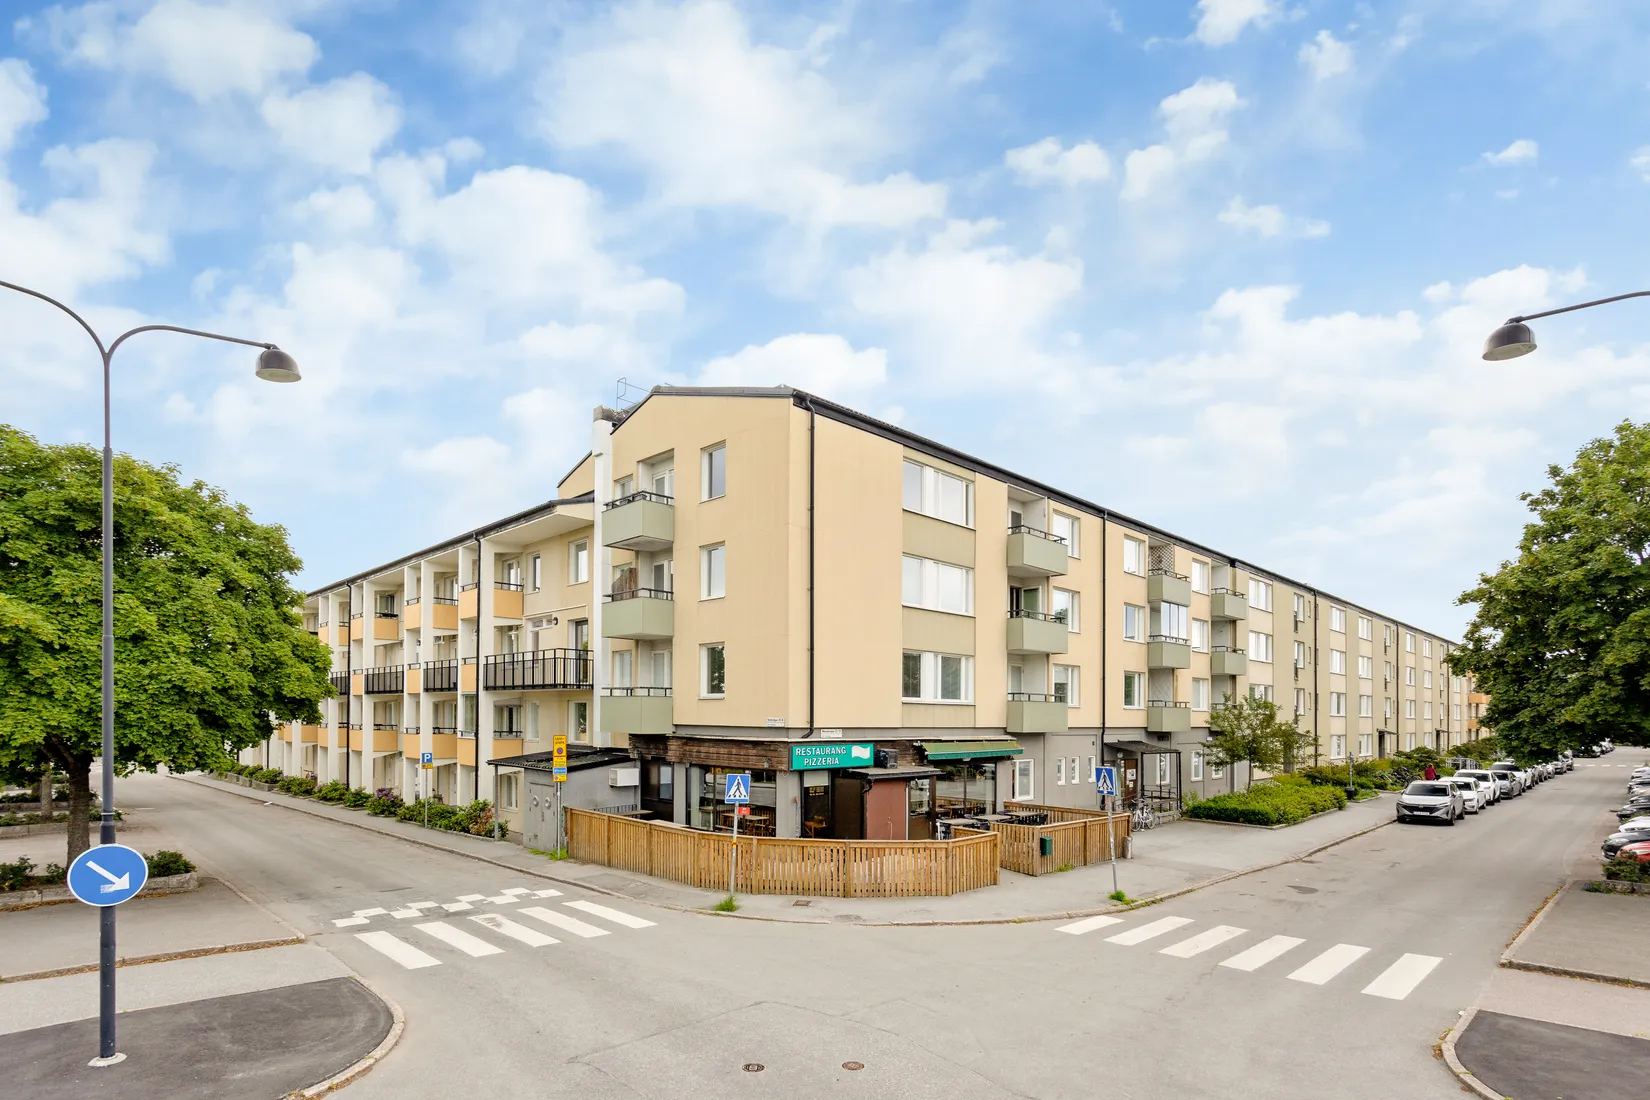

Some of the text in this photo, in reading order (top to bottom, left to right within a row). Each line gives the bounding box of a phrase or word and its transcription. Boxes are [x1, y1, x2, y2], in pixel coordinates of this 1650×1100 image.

[795, 746, 847, 756] RESTAURANG
[424, 753, 431, 763] P
[804, 757, 840, 766] PIZZERIA
